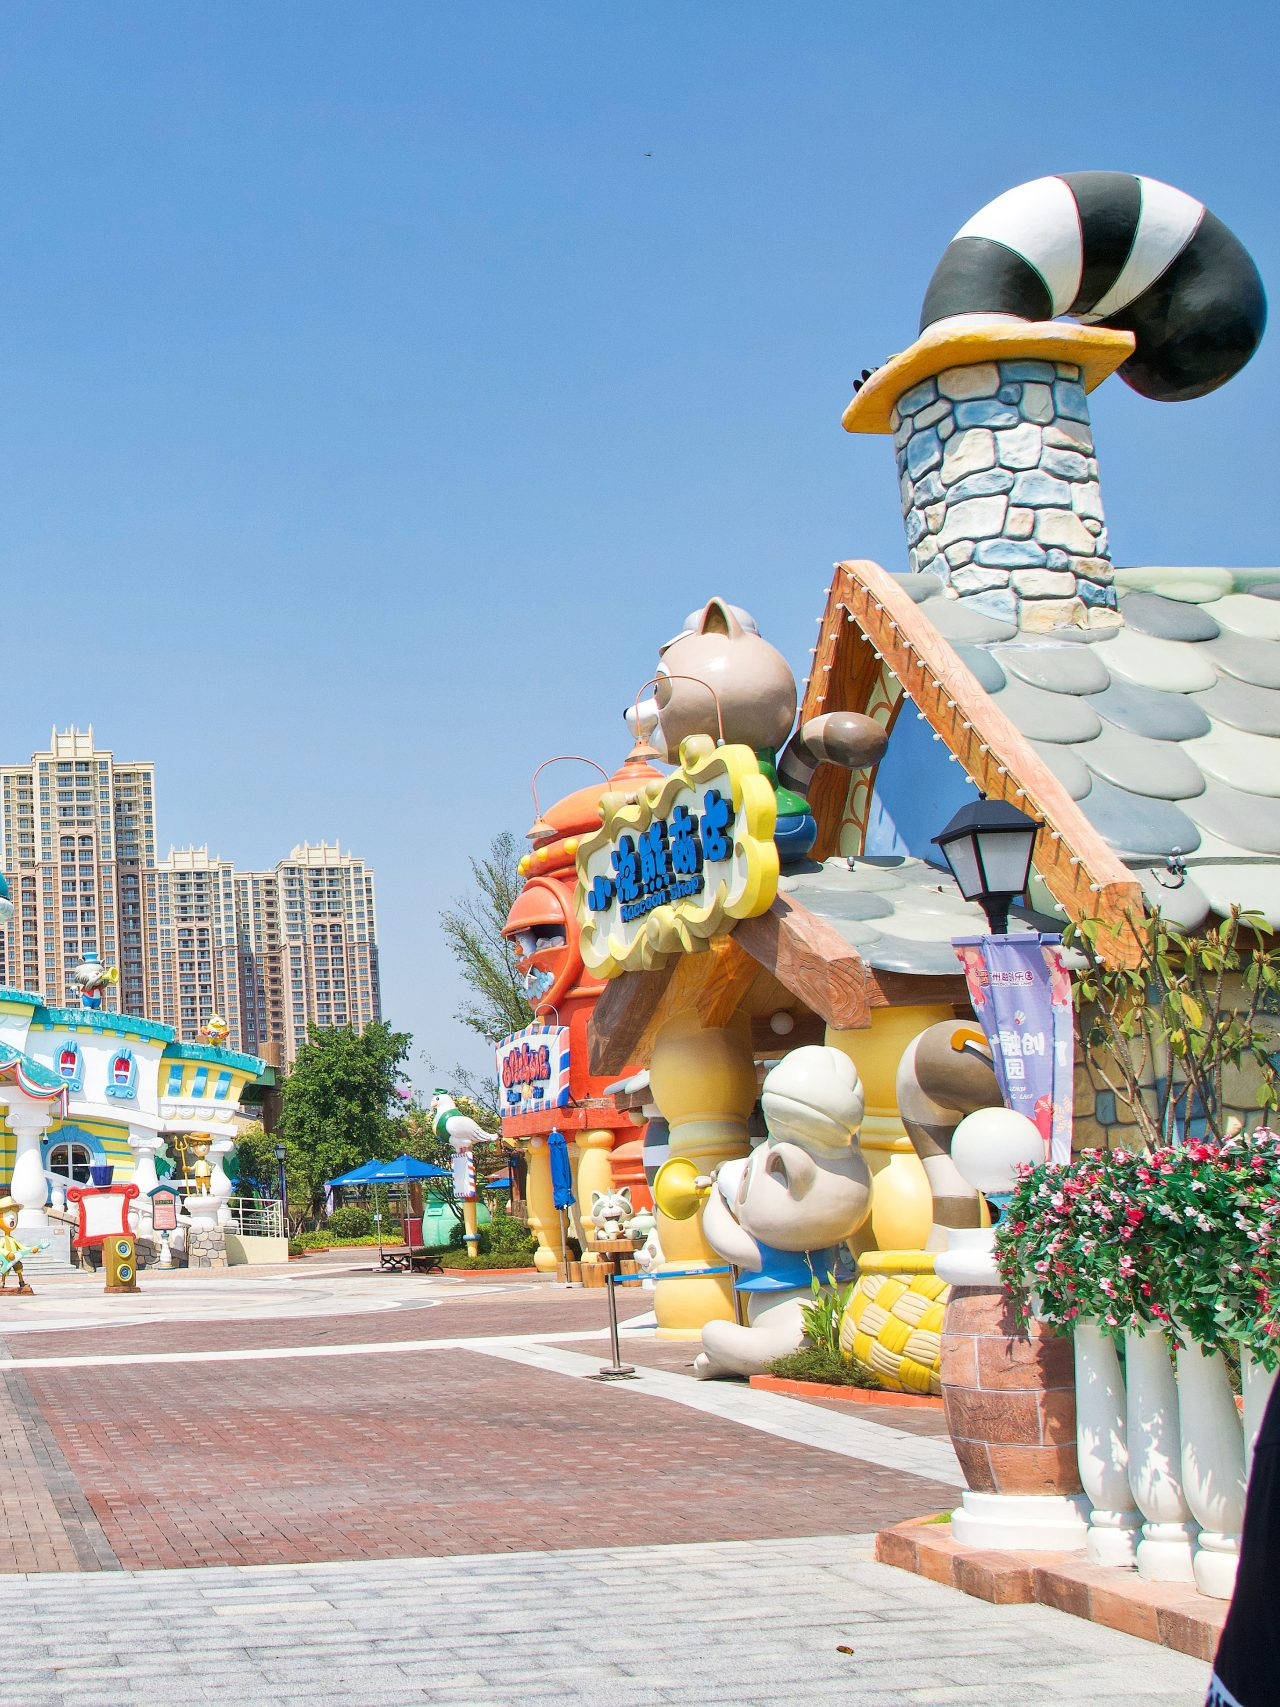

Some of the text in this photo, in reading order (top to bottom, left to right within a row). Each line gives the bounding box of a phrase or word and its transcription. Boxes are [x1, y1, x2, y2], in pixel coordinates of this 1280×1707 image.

[588, 790, 734, 911] 小浣熊商店
[620, 876, 704, 923] Raccoon Shop
